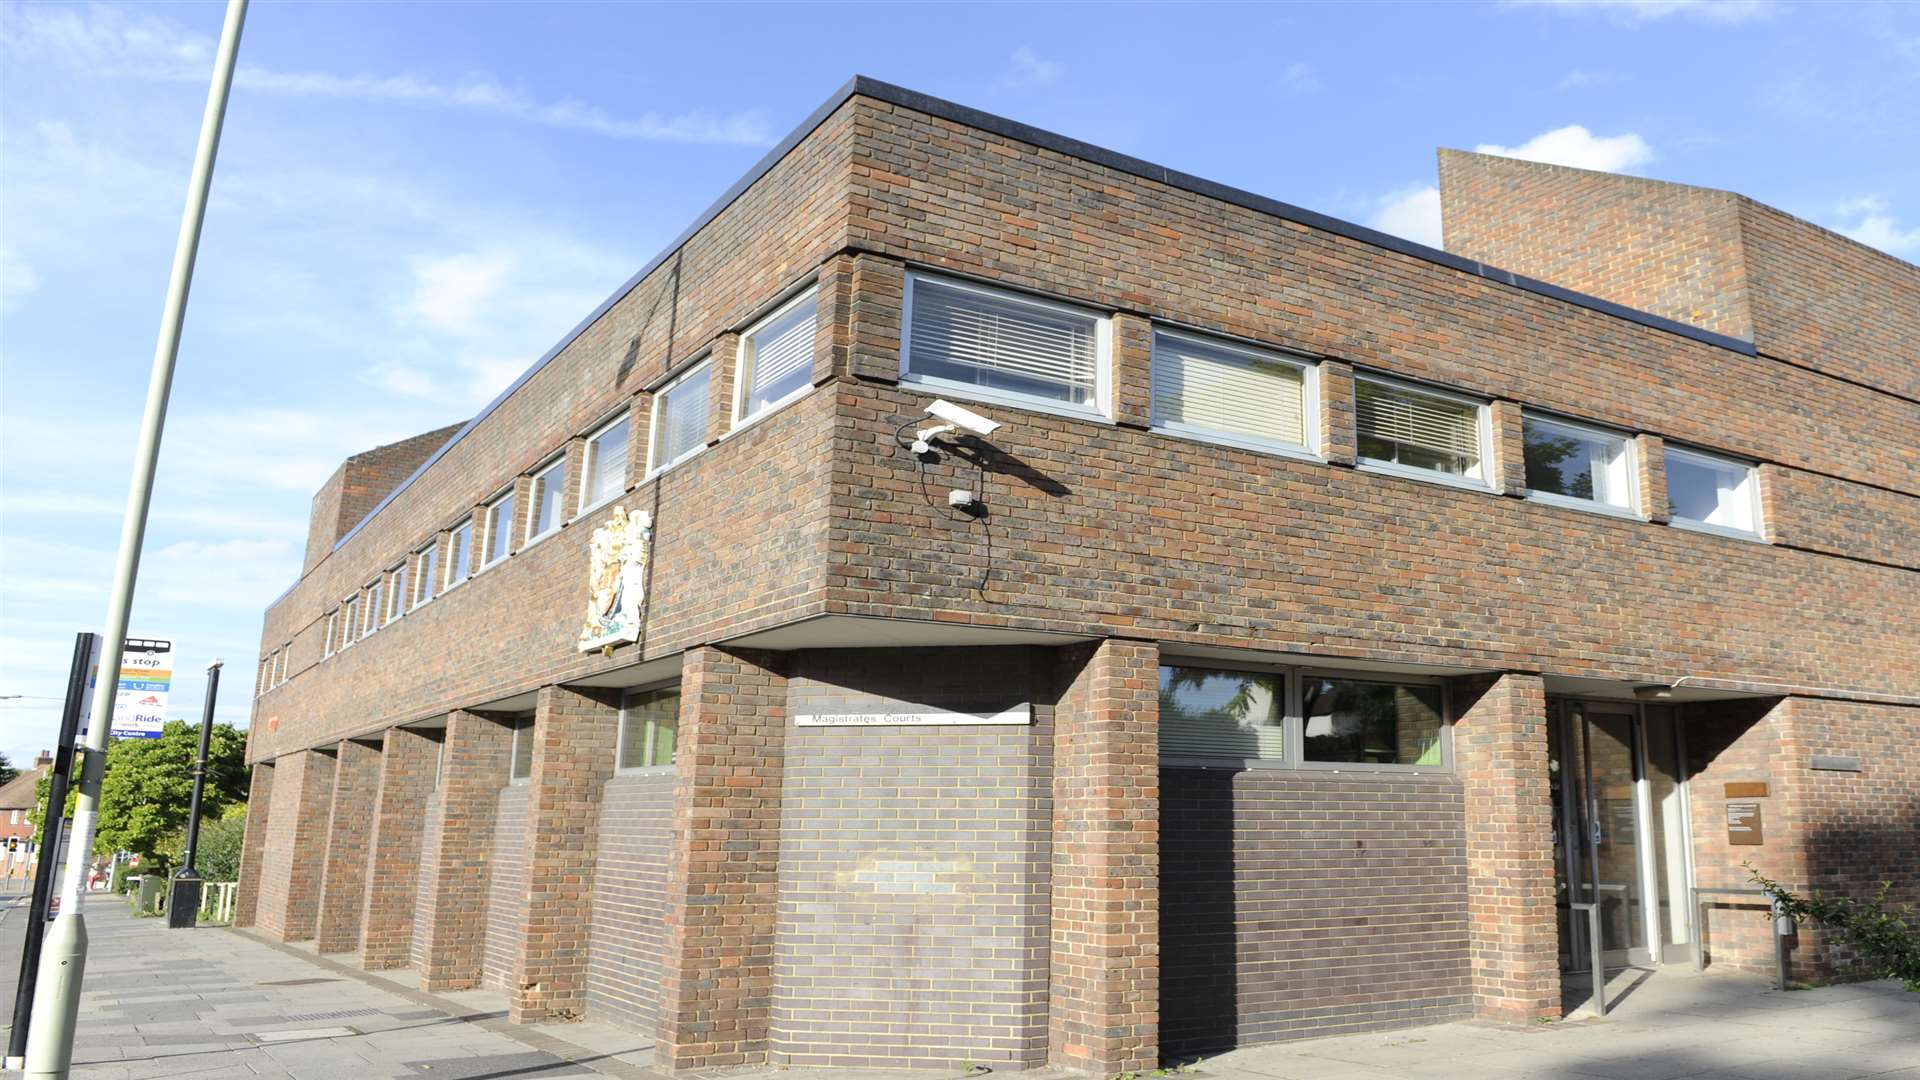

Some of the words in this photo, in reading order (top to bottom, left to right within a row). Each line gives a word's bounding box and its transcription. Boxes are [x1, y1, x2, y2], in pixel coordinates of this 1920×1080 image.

[132, 658, 160, 668] stop
[812, 713, 877, 724] Magistrates
[883, 713, 922, 723] Courts
